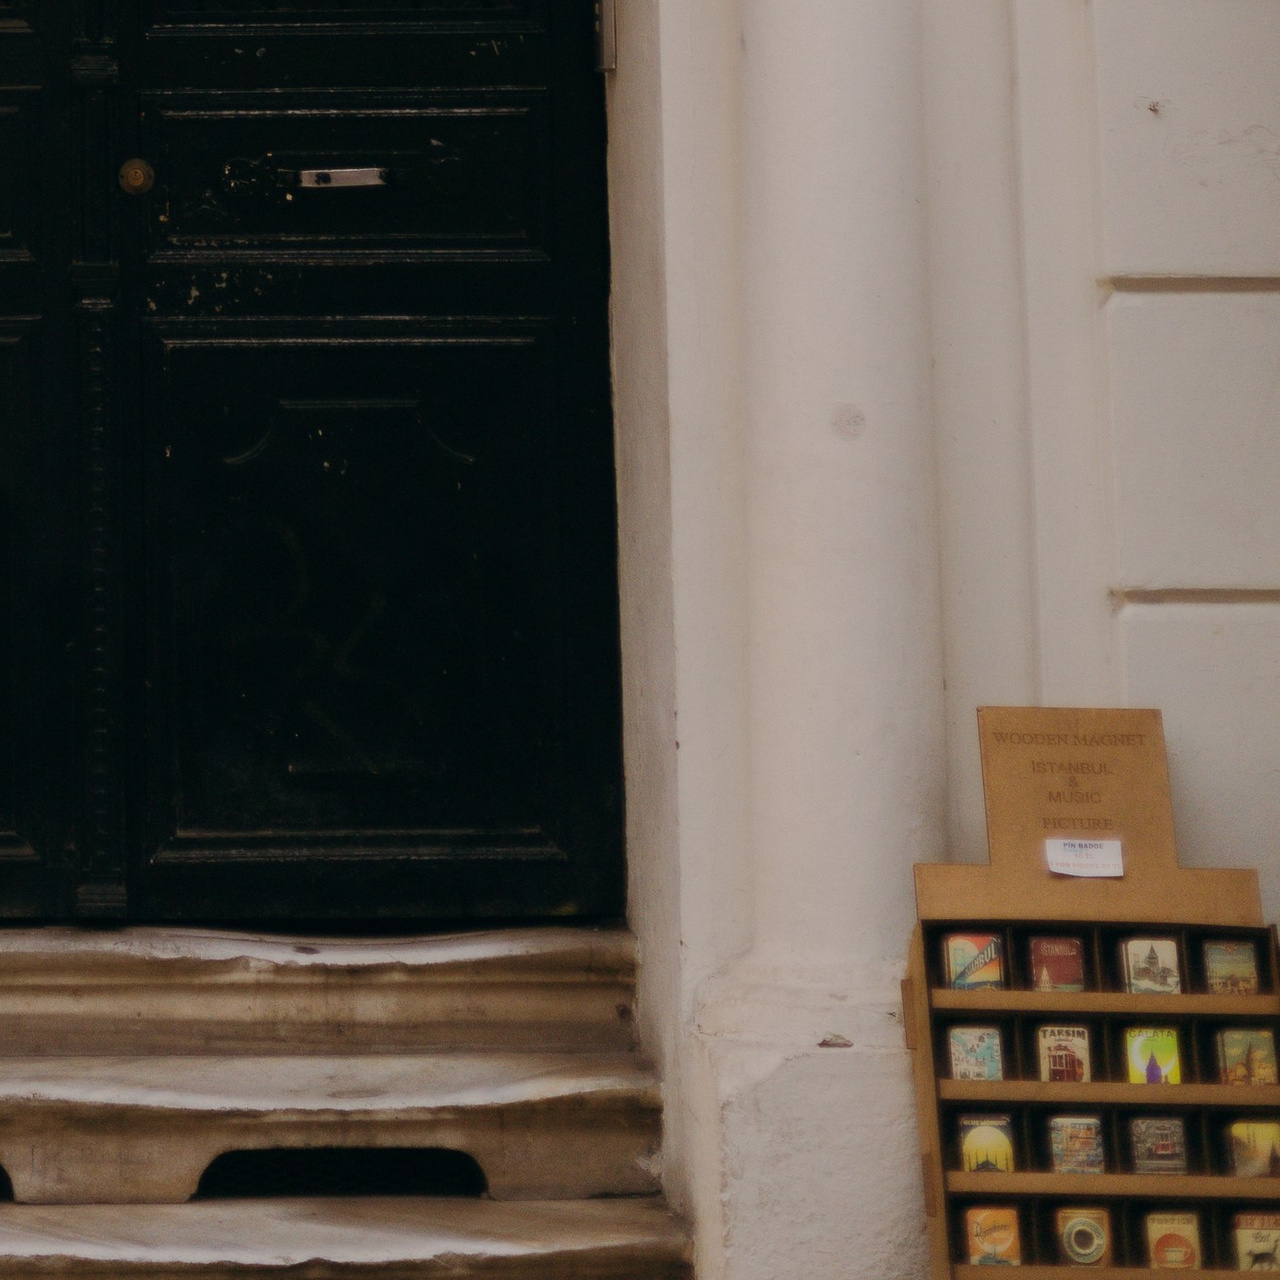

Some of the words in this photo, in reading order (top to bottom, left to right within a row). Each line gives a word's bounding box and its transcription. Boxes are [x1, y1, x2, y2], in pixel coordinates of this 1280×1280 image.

[991, 731, 1069, 747] WOODEN
[1073, 733, 1147, 747] MAGNET
[1068, 775, 1078, 788] &
[1048, 791, 1102, 805] MUSIC
[1042, 816, 1113, 831] PICTURE
[1078, 842, 1104, 850] BADGE
